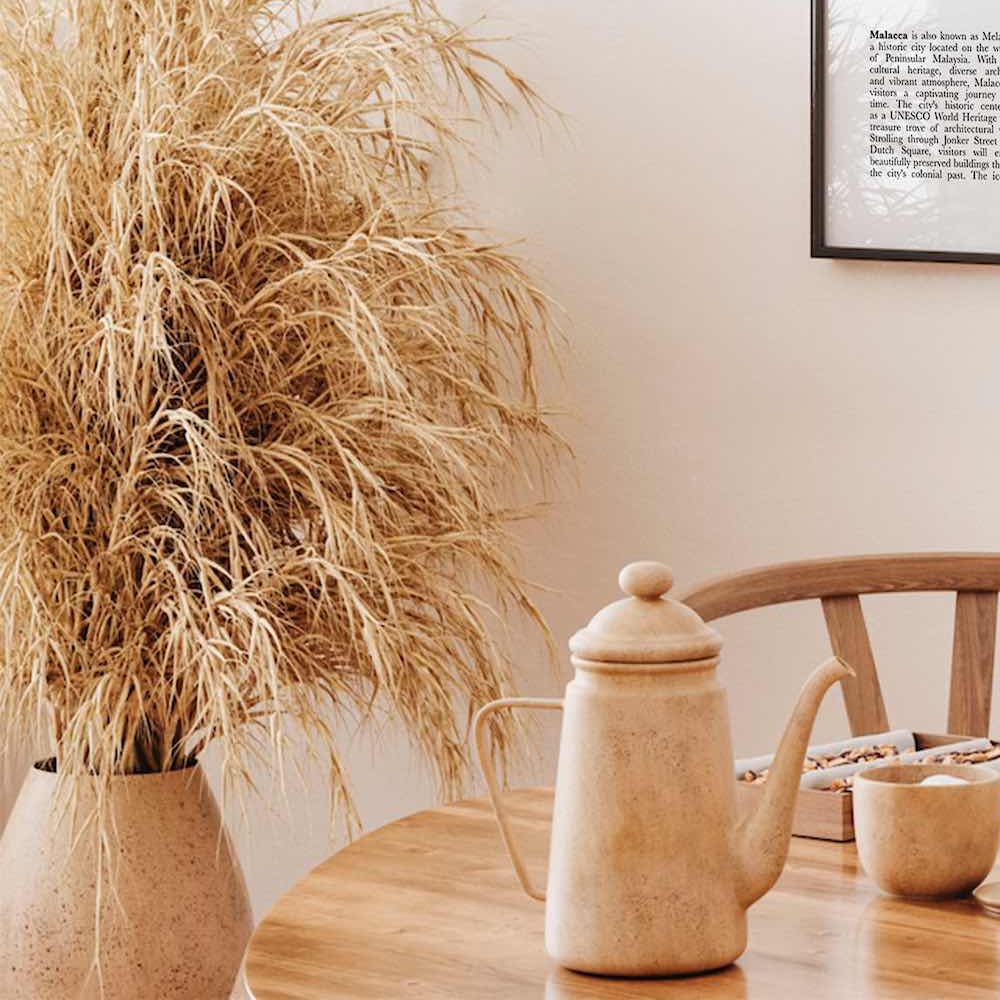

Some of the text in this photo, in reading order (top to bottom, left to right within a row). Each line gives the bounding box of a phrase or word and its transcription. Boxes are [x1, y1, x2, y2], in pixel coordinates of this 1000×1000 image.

[870, 31, 908, 40] Malacca
[912, 31, 918, 40] is
[921, 31, 937, 40] also
[940, 31, 967, 40] known
[869, 54, 877, 63] of
[885, 54, 926, 63] Peninsular
[932, 54, 971, 66] Malaysia.
[977, 55, 997, 64] With
[869, 65, 900, 74] cultural
[908, 65, 942, 77] heritage,
[949, 66, 977, 75] diverse
[869, 76, 885, 86] and
[889, 77, 917, 86] vibrant
[922, 77, 970, 89] atmosphere,
[869, 88, 897, 97] visitors
[916, 89, 959, 101] captivating
[966, 90, 996, 101] journey
[870, 99, 889, 109] time.
[896, 100, 912, 109] The
[918, 100, 938, 112] city's
[945, 101, 974, 110] historic
[870, 123, 901, 132] treasure
[906, 124, 926, 132] trove
[930, 123, 938, 132] of
[944, 124, 994, 134] architectural
[870, 133, 903, 146] Strolling
[908, 134, 939, 146] through
[942, 135, 969, 147] Jonker
[973, 136, 997, 146] Street
[870, 145, 894, 154] Dutch
[901, 146, 931, 158] Square,
[938, 147, 966, 156] visitors
[973, 148, 987, 157] will
[870, 156, 911, 169] beautifully
[913, 158, 951, 170] preserved
[953, 159, 990, 171] buildings
